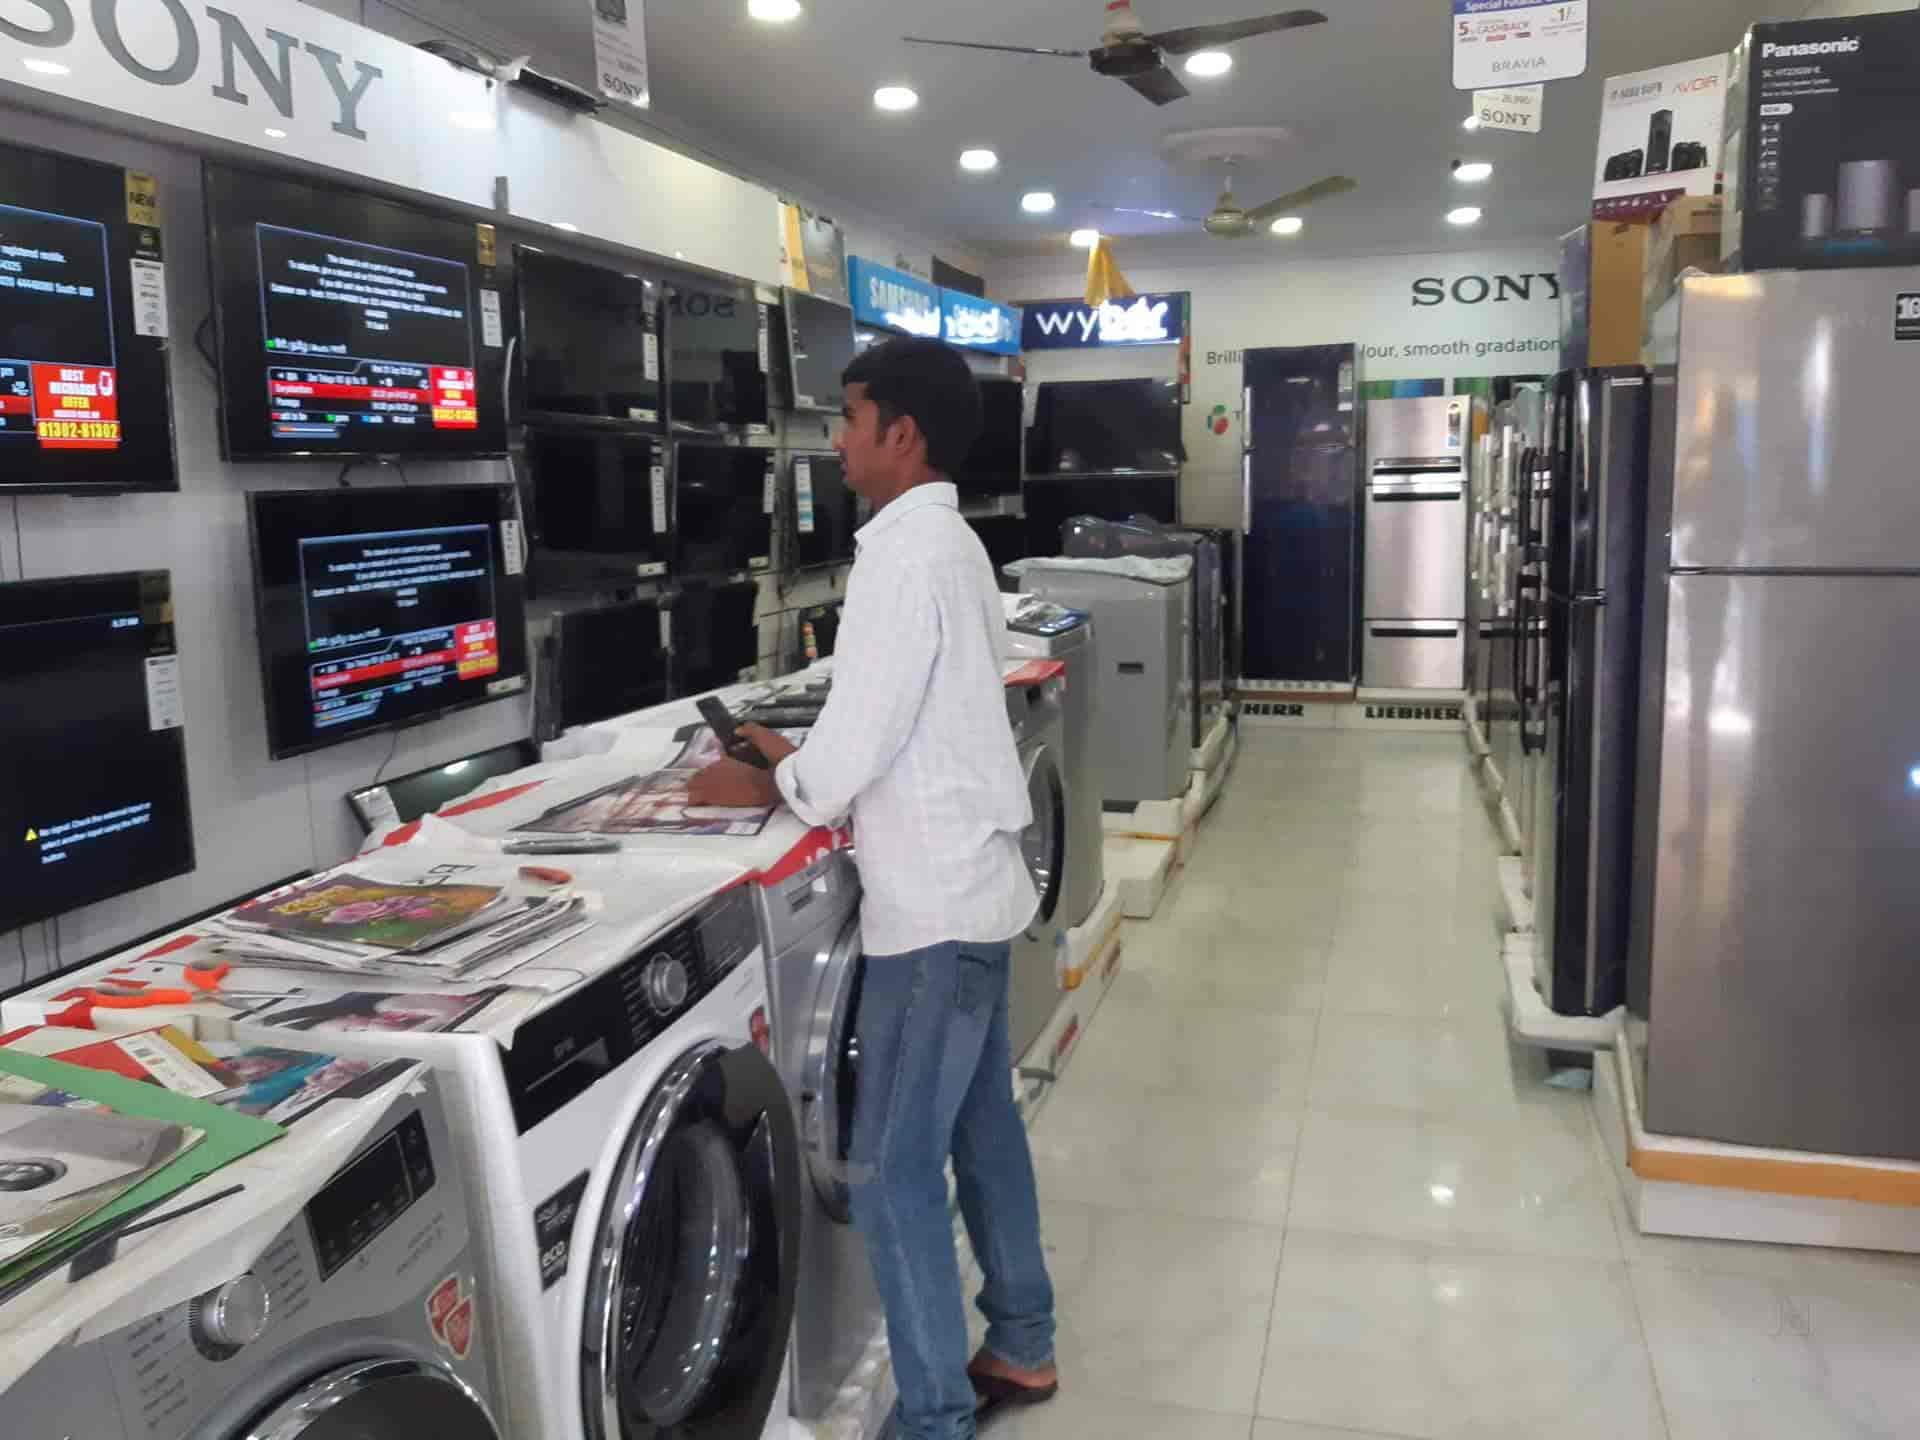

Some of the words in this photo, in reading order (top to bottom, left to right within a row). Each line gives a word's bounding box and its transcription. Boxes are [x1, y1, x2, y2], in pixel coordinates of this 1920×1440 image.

[1762, 36, 1859, 58] Panasonic
[1492, 57, 1546, 72] BRAVIA
[603, 72, 643, 97] SONY
[1481, 108, 1532, 126] SONY
[1412, 273, 1560, 306] SONY
[1207, 351, 1241, 365] Brilli
[1361, 343, 1398, 359] lour,
[1404, 339, 1470, 357] smooth
[1475, 337, 1560, 358] gradation
[1243, 703, 1304, 717] HERR
[1365, 705, 1464, 721] LIEBHER
